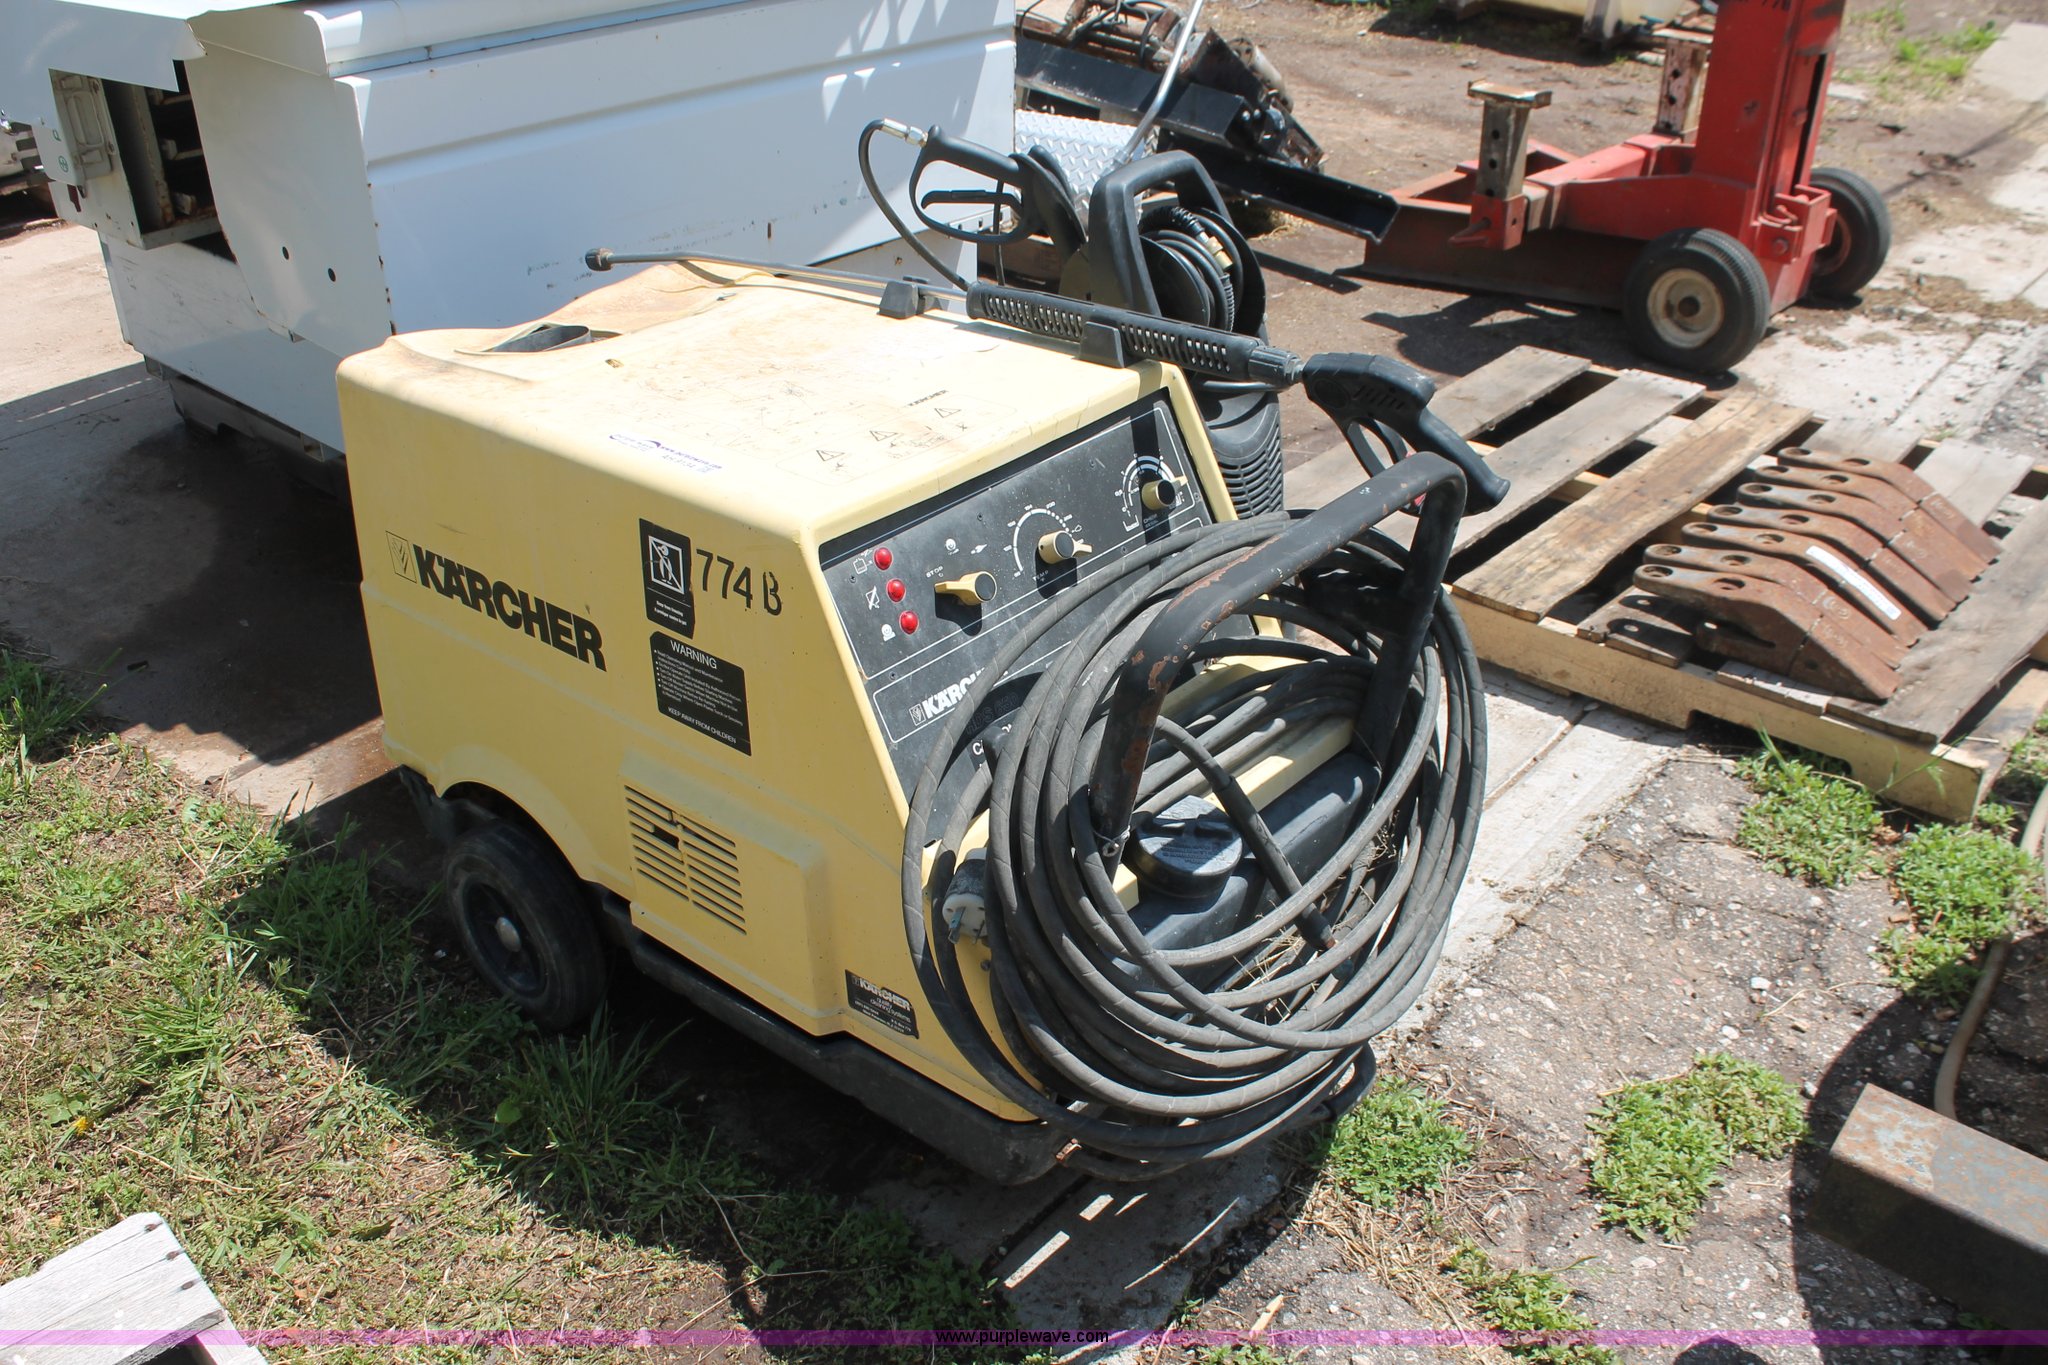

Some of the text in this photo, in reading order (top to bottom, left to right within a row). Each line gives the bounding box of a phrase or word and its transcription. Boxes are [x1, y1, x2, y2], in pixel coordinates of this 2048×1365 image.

[925, 565, 944, 578] STOP
[413, 544, 607, 672] KÄRCHER
[670, 640, 717, 669] WARNING
[668, 706, 681, 717] KEEP
[695, 720, 710, 731] FROM
[710, 727, 737, 743] CHILDREN
